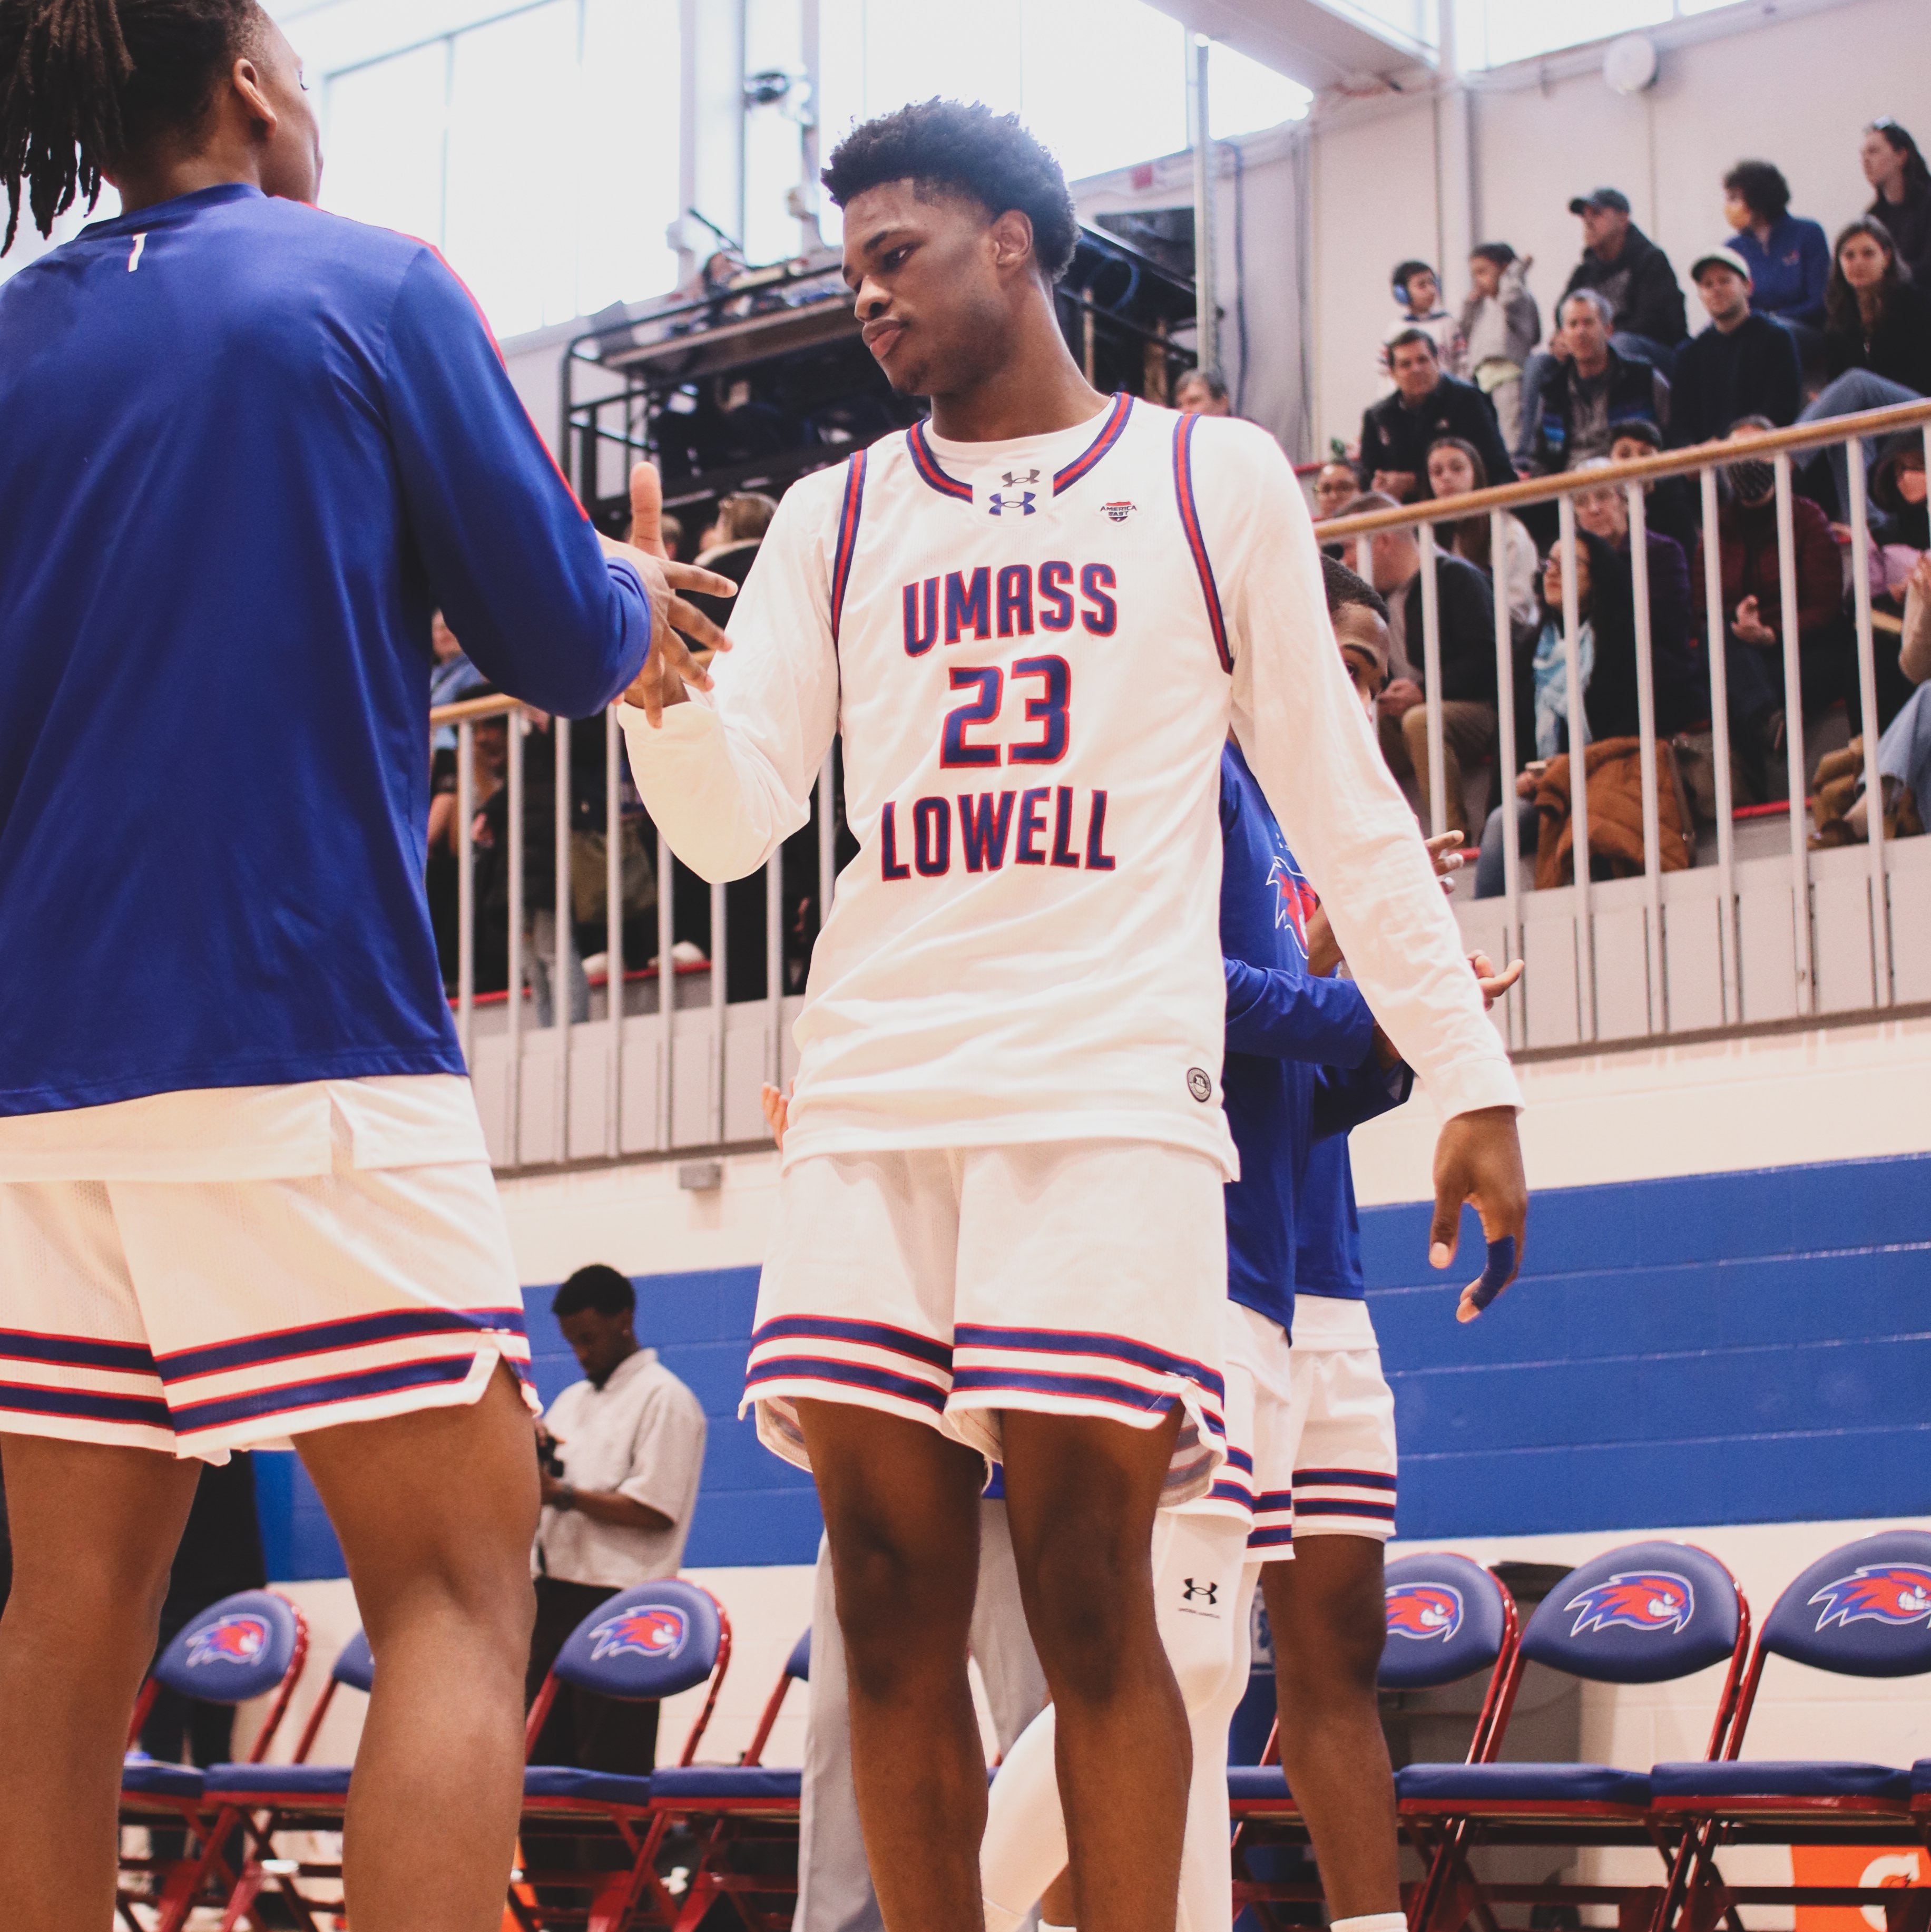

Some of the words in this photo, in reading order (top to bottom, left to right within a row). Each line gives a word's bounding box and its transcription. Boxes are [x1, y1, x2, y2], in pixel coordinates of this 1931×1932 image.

[128, 233, 148, 272] 1
[903, 560, 1118, 657] UMASS
[939, 654, 1071, 769] 23
[881, 785, 1116, 882] LOWELL
